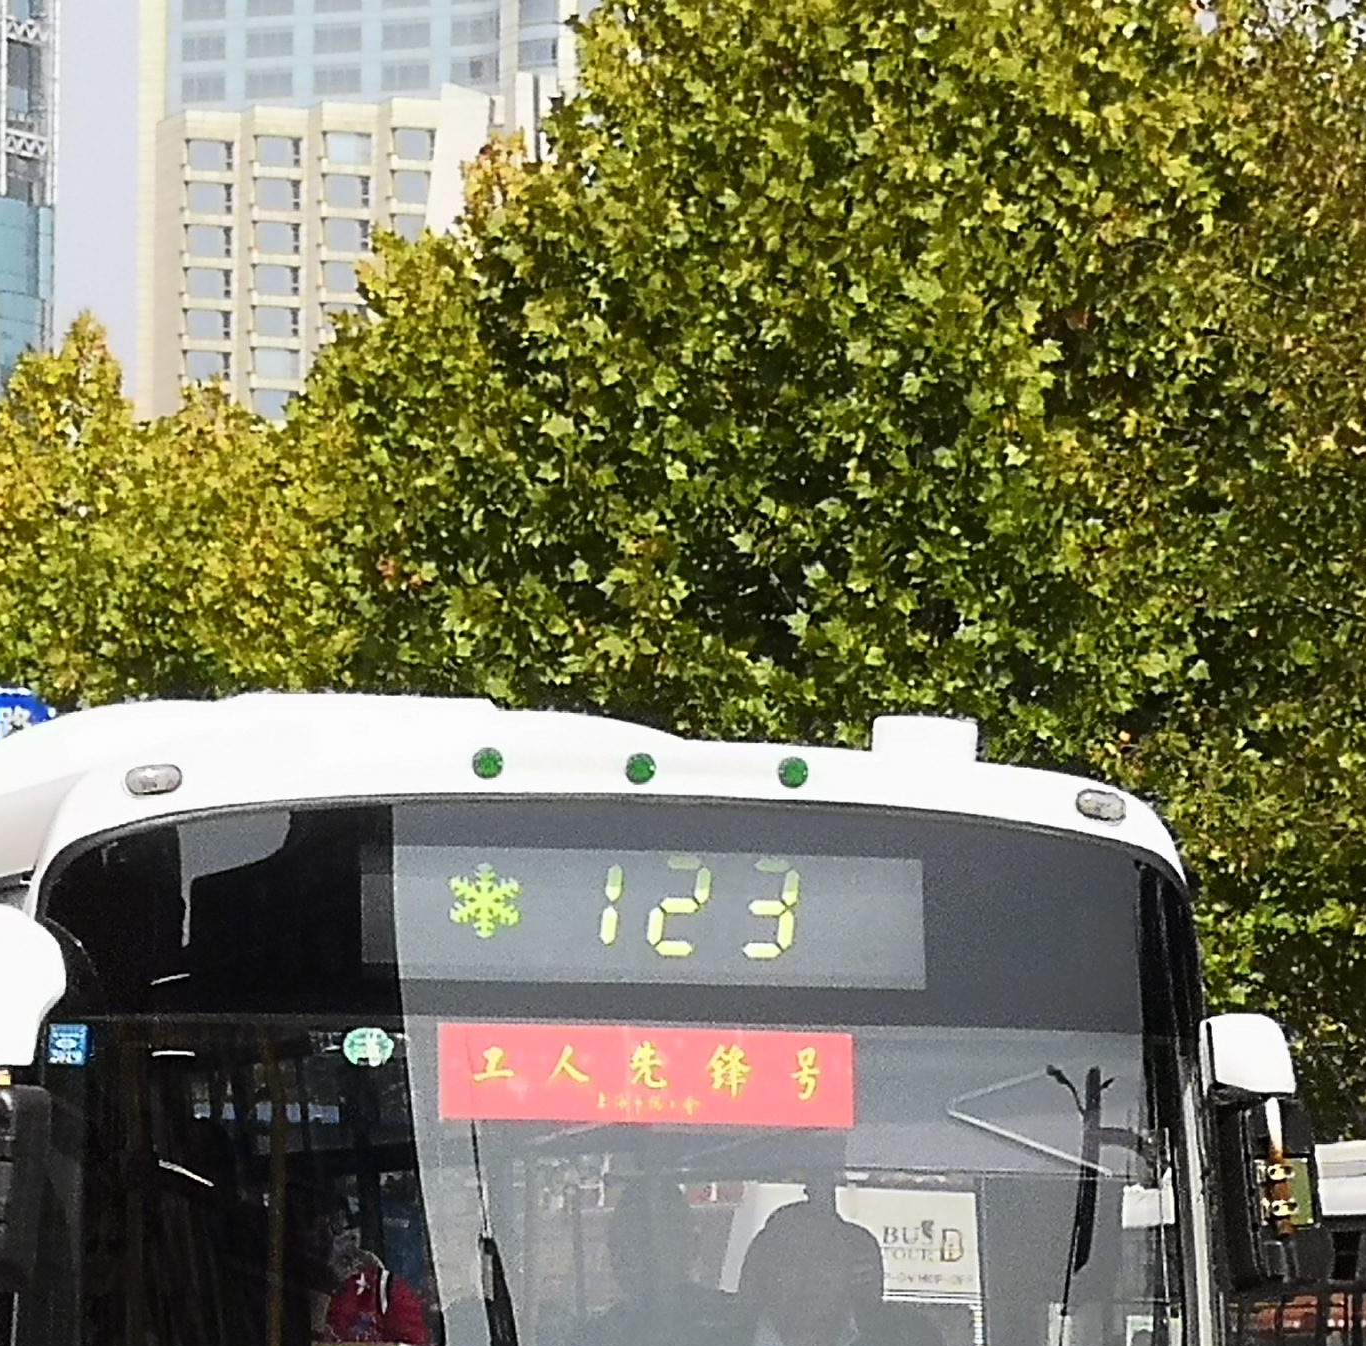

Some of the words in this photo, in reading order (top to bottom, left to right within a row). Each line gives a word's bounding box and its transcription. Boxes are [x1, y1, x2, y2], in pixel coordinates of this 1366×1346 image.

[600, 856, 801, 959] 123
[472, 1041, 821, 1101] 工人先锋号
